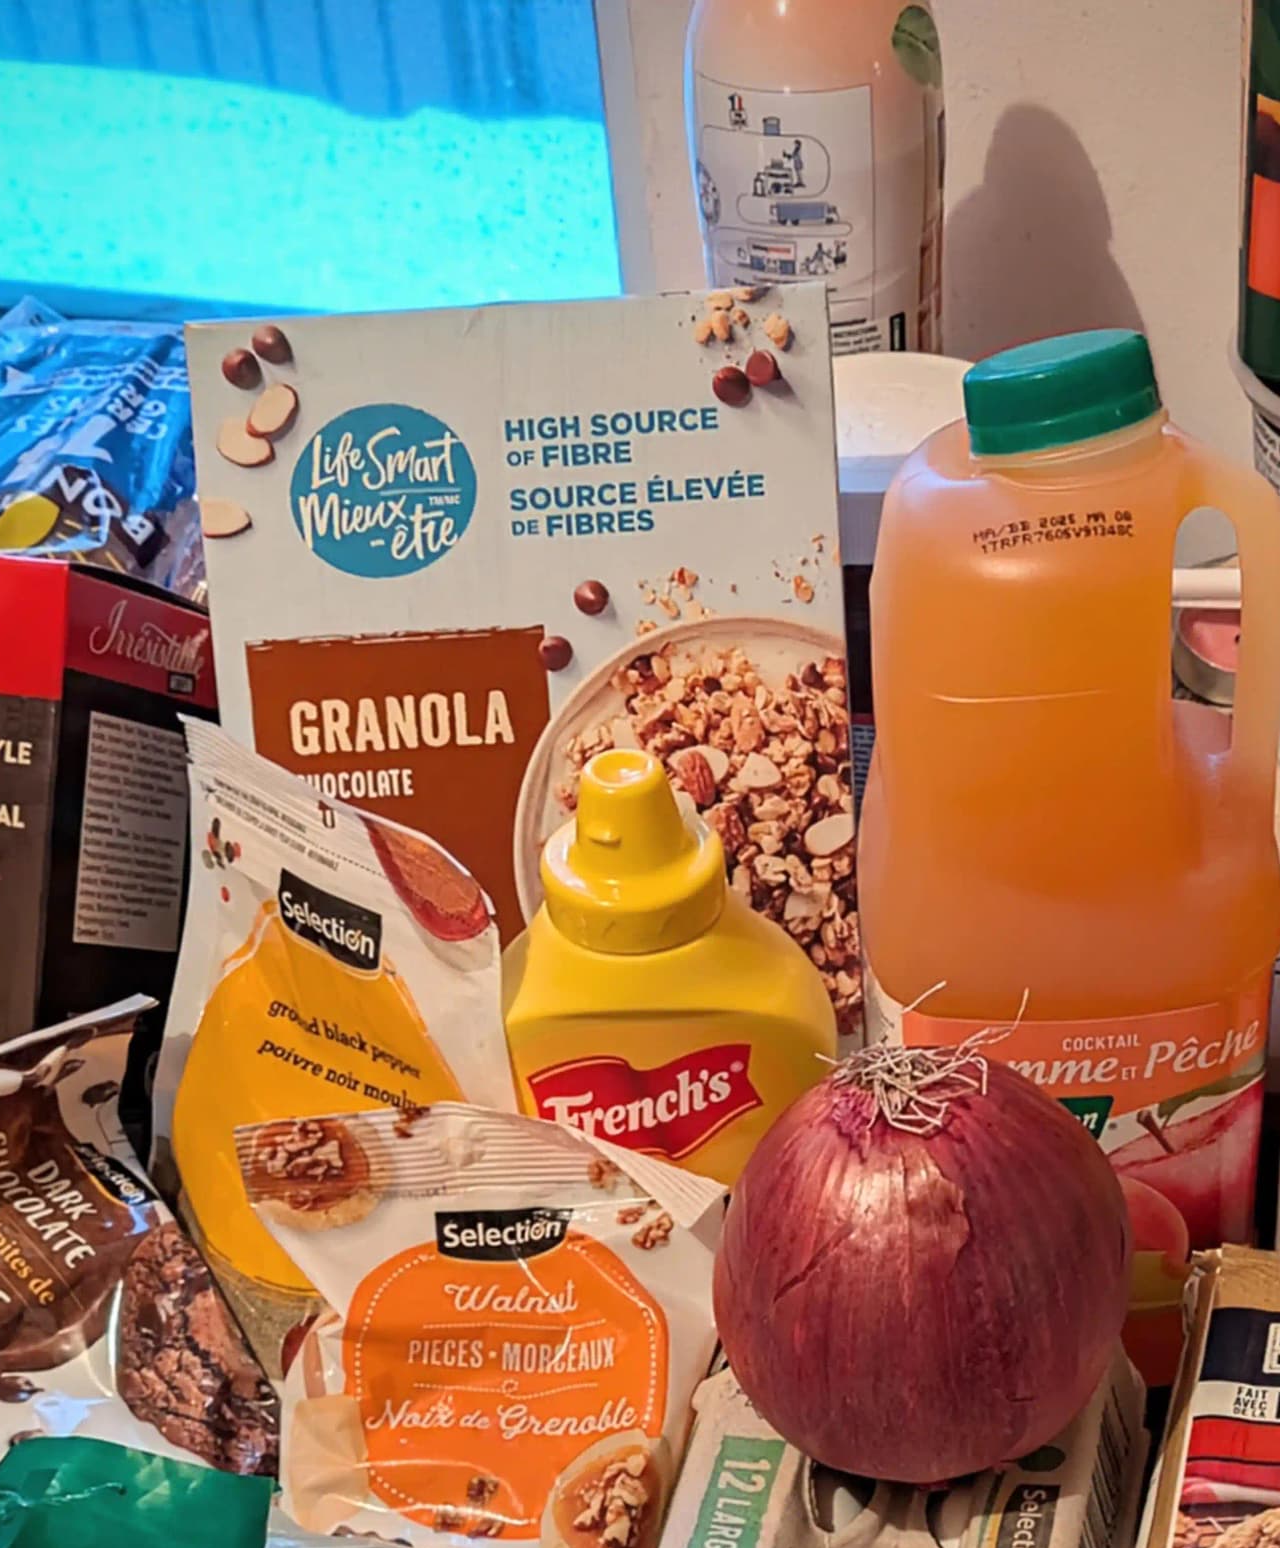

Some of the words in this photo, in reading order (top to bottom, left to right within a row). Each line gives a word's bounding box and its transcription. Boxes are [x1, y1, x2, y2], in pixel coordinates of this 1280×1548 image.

[505, 417, 581, 442] HIGH
[590, 407, 719, 438] SOURCE
[310, 434, 366, 490] Life
[364, 427, 459, 487] Smart
[507, 450, 536, 467] OF
[541, 442, 632, 468] FIBRE
[509, 482, 637, 511] SOURCE
[647, 473, 766, 504] ÉLEVÉE
[299, 494, 407, 548] Mieux
[512, 519, 539, 536] DE
[546, 509, 654, 537] FIBRES
[289, 690, 515, 756] GRANOLA
[281, 891, 376, 960] Selection
[321, 1013, 369, 1053] black
[1062, 1033, 1141, 1053] COCKTAIL
[1121, 1065, 1137, 1081] ET
[1143, 1019, 1260, 1079] Pêche
[257, 1037, 323, 1078] poivre
[325, 1065, 360, 1093] noir
[542, 1067, 732, 1136] French's
[26, 1158, 97, 1222] DARK
[443, 1218, 561, 1248] Selection
[444, 1280, 578, 1313] Walnut
[408, 1339, 484, 1369] PIECES
[501, 1338, 615, 1373] MORCEAUX
[1237, 1386, 1268, 1402] FAIT
[497, 1397, 638, 1440] Grenoble
[716, 1458, 772, 1496] 12
